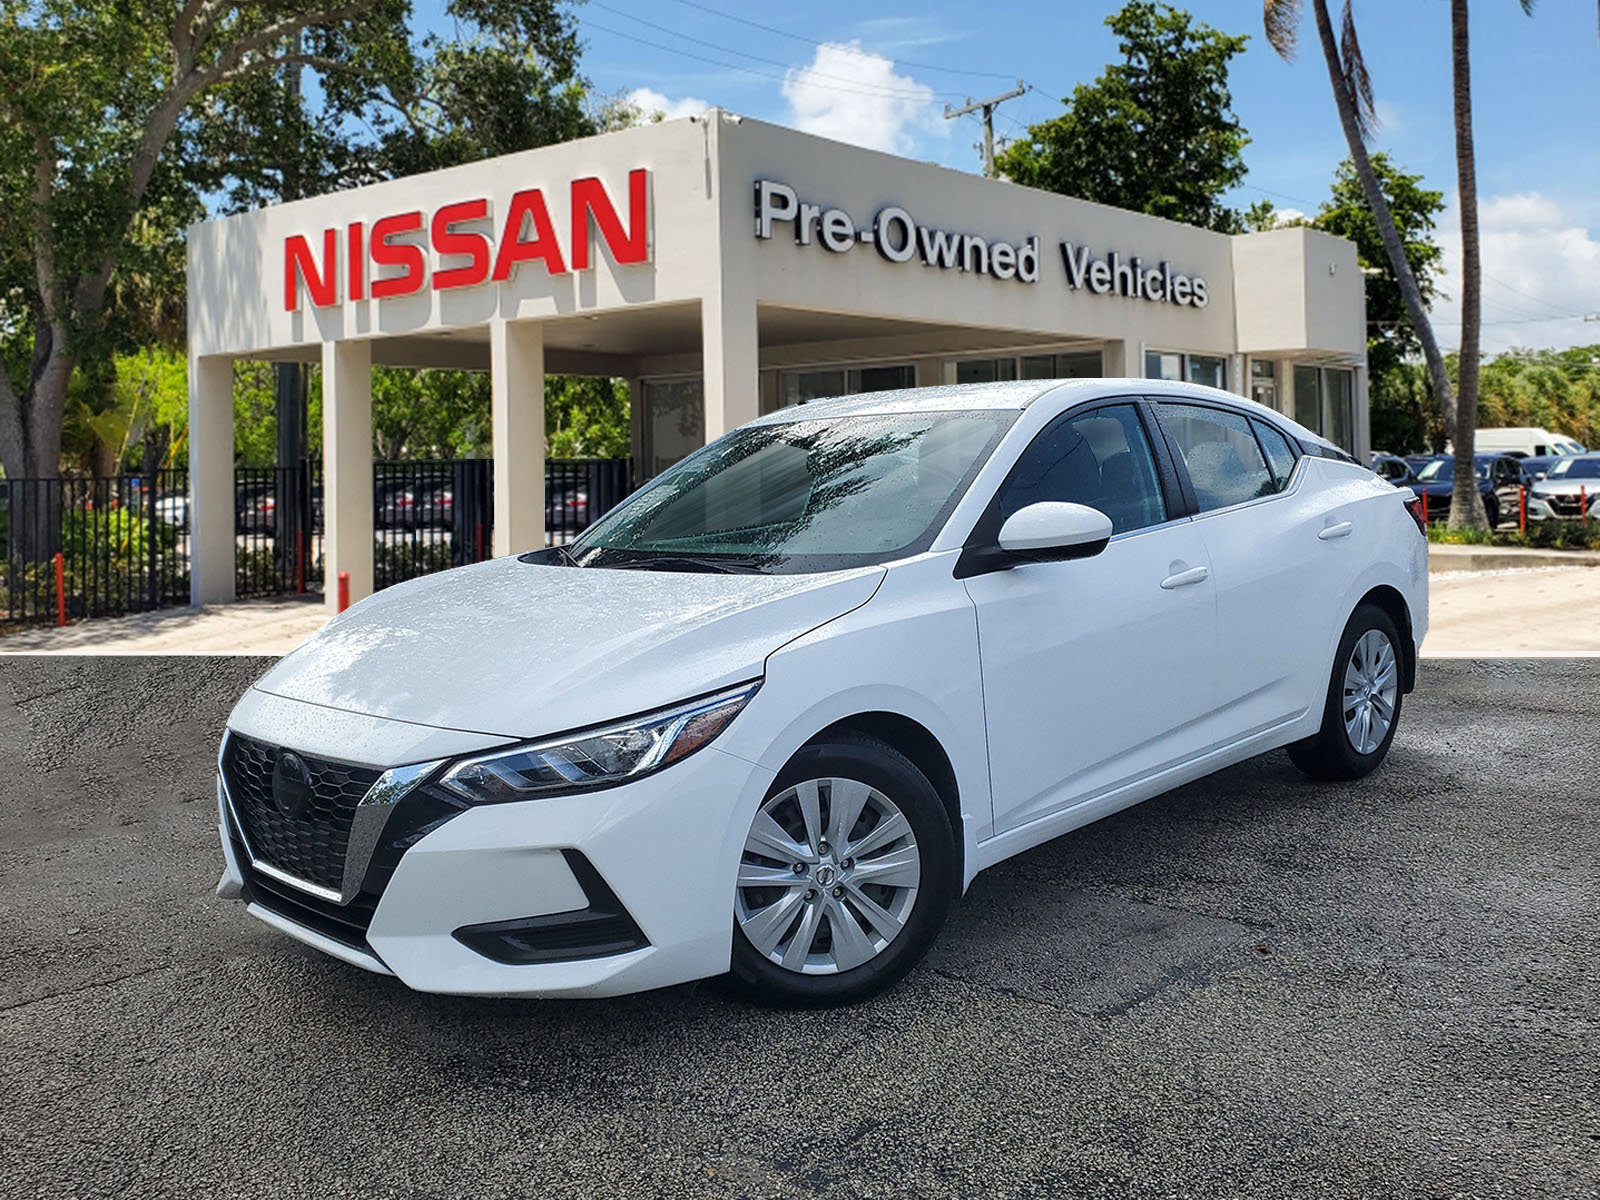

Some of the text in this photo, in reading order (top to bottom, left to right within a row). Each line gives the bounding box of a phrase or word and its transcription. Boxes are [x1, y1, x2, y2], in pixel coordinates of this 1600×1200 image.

[284, 168, 649, 312] NISSAN
[755, 180, 1209, 308] Pre-Owned Vehicles
